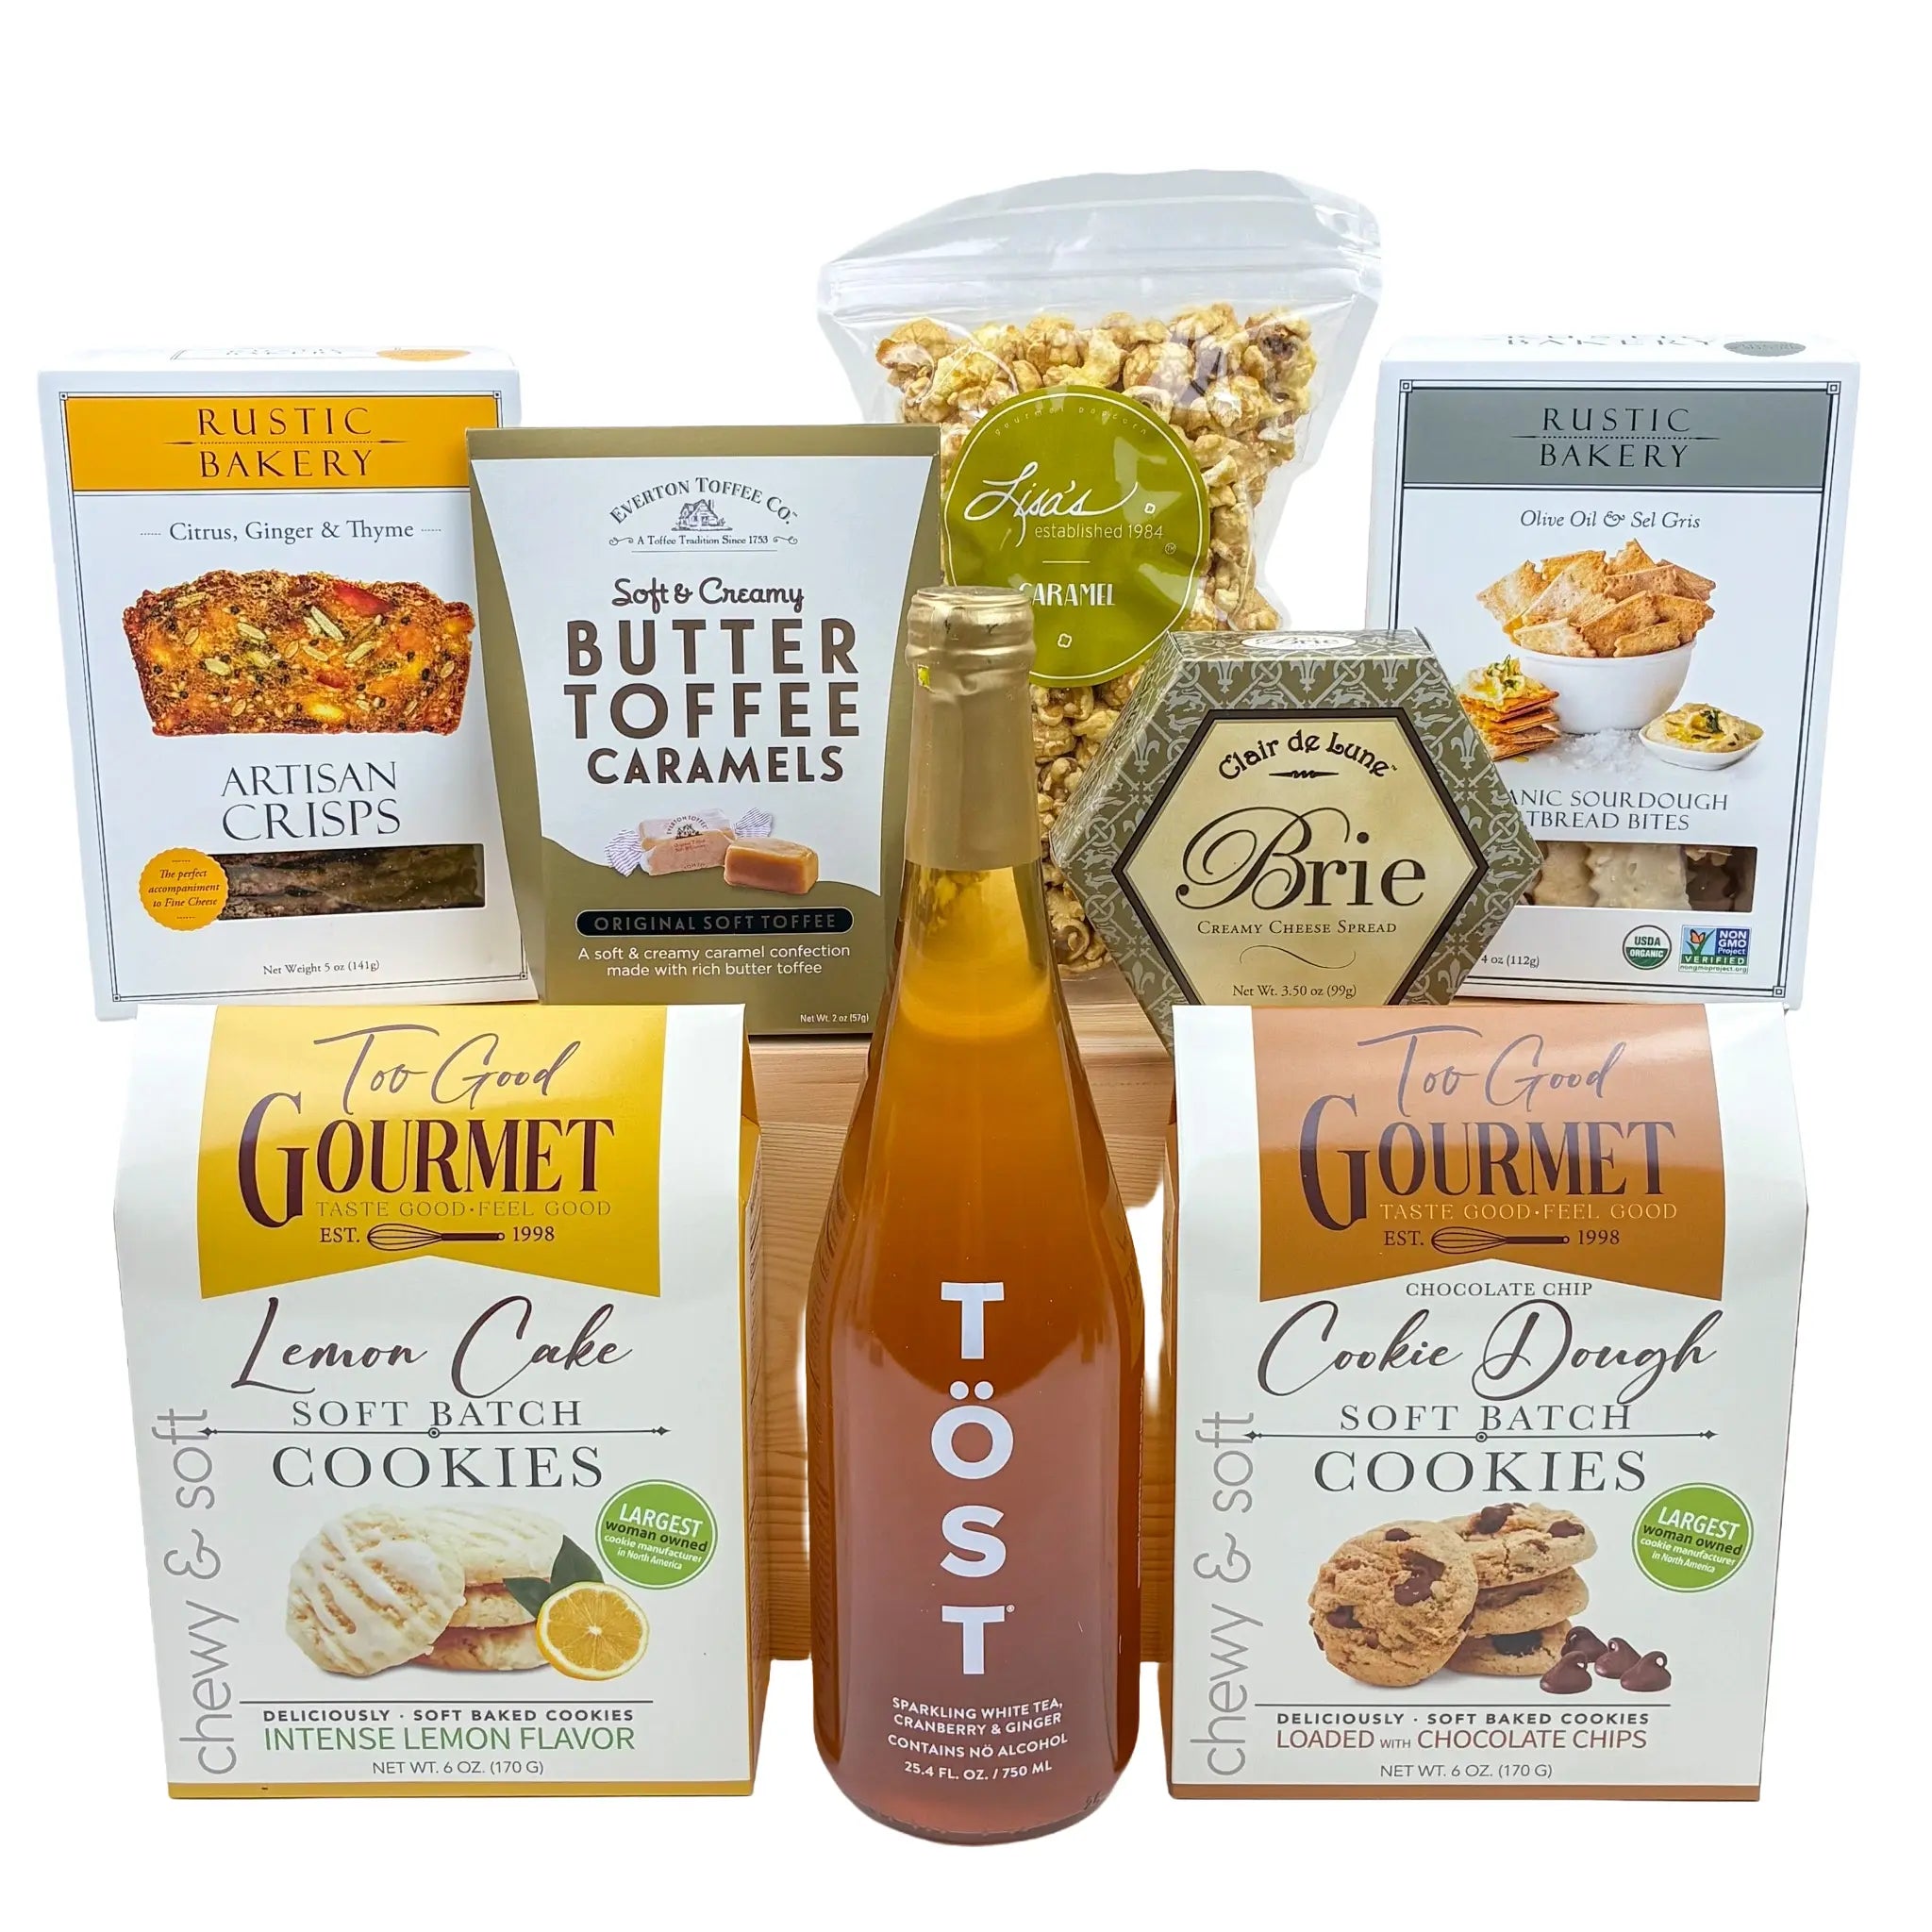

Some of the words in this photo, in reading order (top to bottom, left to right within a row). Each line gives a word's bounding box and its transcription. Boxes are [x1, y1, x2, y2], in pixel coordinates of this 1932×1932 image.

[197, 407, 373, 436] RUSTIC
[1542, 407, 1690, 433] RUSTIC
[201, 448, 374, 478] BAKERY
[1540, 442, 1689, 469] BAKERY
[609, 479, 691, 525] EVERTON
[695, 476, 763, 505] TOFFEE
[963, 461, 1140, 548] Lisa's
[169, 521, 238, 543] Citrus,
[245, 521, 313, 545] Ginger
[321, 522, 340, 540] &
[346, 518, 414, 543] Thyme
[1034, 524, 1123, 540] established
[1128, 524, 1164, 540] 1984
[1521, 510, 1565, 528] Olive
[1570, 510, 1597, 528] Oil
[1603, 511, 1625, 527] &
[1631, 512, 1656, 528] Sel
[1661, 512, 1701, 529] Gris
[647, 535, 676, 545] Toffee
[678, 535, 720, 545] Tradition
[722, 535, 747, 545] Since
[749, 535, 769, 545] 1753
[611, 576, 669, 614] Soft
[674, 584, 693, 605] &
[699, 576, 805, 613] Creamy
[567, 618, 859, 676] BUTTER
[563, 682, 859, 740] TOFFEE
[588, 745, 843, 785] CARAMELS
[1218, 740, 1279, 780] Clair
[1288, 729, 1321, 754] de
[221, 760, 397, 797] ARTISAN
[1571, 790, 1728, 811] SOURDOUGH
[223, 798, 401, 841] CRISPS
[1525, 810, 1620, 829] TBREAD
[1627, 811, 1690, 831] BITES
[1175, 807, 1426, 911] Brie
[177, 868, 207, 881] perfect
[148, 884, 220, 895] accompaniment
[593, 915, 696, 932] ORIGINAL
[704, 914, 754, 930] SOFT
[761, 913, 836, 929] TOFFEE
[1197, 920, 1262, 935] CREAMY
[1269, 920, 1331, 935] CHEESE
[1337, 920, 1397, 934] SPREAD
[1720, 929, 1747, 940] NON
[578, 947, 590, 960] A
[594, 946, 624, 960] soft
[628, 947, 641, 960] &
[643, 948, 700, 962] creamy
[705, 945, 765, 959] caramel
[769, 944, 851, 958] confection
[1629, 948, 1664, 958] ORGANIC
[1634, 936, 1660, 947] USDA
[1718, 939, 1747, 948] GMO
[1718, 947, 1746, 957] Project
[263, 964, 281, 976] Net
[285, 961, 321, 977] Weight
[348, 959, 380, 974] (141g)
[607, 963, 649, 976] made
[654, 962, 688, 975] with
[692, 962, 721, 975] rich
[725, 961, 773, 975] butter
[776, 961, 823, 974] toffee
[1507, 955, 1540, 969] (112g)
[1685, 956, 1745, 965] VERIFIED
[1232, 984, 1255, 998] Net
[1257, 984, 1278, 998] Wt.
[1281, 984, 1307, 998] 3.50
[1326, 983, 1357, 1001] (99g)
[313, 1024, 440, 1115] Too
[430, 1032, 581, 1111] Good
[1357, 1024, 1483, 1117] Too
[1485, 1034, 1627, 1112] Good
[238, 1091, 615, 1229] GOURMET
[1299, 1093, 1676, 1231] GOURMET
[316, 1201, 389, 1218] TASTE
[544, 1200, 612, 1217] GOOD
[1380, 1203, 1454, 1221] TASTE
[1610, 1203, 1678, 1220] GOOD
[320, 1227, 360, 1244] EST.
[512, 1225, 556, 1243] 1998
[1383, 1229, 1425, 1247] EST.
[1577, 1228, 1620, 1246] 1998
[1406, 1282, 1536, 1297] CHOCOLATE
[1542, 1281, 1592, 1297] CHIP
[230, 1296, 427, 1394] Lemon
[450, 1295, 633, 1399] Cake
[1257, 1300, 1464, 1396] Cookie
[1472, 1298, 1724, 1405] Dough
[292, 1400, 409, 1427] SOFT
[430, 1399, 582, 1427] BATCH
[1340, 1405, 1458, 1432] SOFT
[1483, 1403, 1632, 1431] BATCH
[151, 1407, 216, 1510] soft
[272, 1445, 603, 1490] COOKIES
[1194, 1410, 1255, 1514] soft
[1313, 1449, 1646, 1493] COOKIES
[619, 1502, 704, 1539] LARGEST
[1657, 1506, 1740, 1541] LARGEST
[604, 1534, 637, 1548] cookie
[637, 1541, 703, 1563] manufacturer
[606, 1520, 657, 1541] woman
[659, 1533, 708, 1553] owned
[1643, 1524, 1693, 1545] woman
[1695, 1537, 1743, 1557] owned
[650, 1555, 683, 1571] America
[1641, 1537, 1673, 1551] cookie
[1673, 1544, 1737, 1566] manufacturer
[1684, 1557, 1716, 1574] America
[178, 1600, 240, 1775] chewy
[1190, 1603, 1264, 1776] chewy
[263, 1709, 391, 1723] DELICIOUSLY
[413, 1708, 461, 1723] SOFT
[472, 1708, 537, 1723] BAKED
[546, 1708, 635, 1723] COOKIES
[892, 1697, 977, 1720] SPARKLING
[981, 1704, 1029, 1720] WHITE
[1033, 1697, 1063, 1715] TEA,
[1277, 1712, 1405, 1726] DELICIOUSLY
[1427, 1712, 1475, 1725] SOFT
[1486, 1712, 1552, 1725] BAKED
[1560, 1712, 1650, 1725] COOKIES
[893, 1713, 986, 1736] CRANBERRY
[991, 1724, 1002, 1735] &
[1006, 1711, 1062, 1734] GINGER
[264, 1726, 395, 1751] INTENSE
[405, 1726, 511, 1751] LEMON
[521, 1726, 636, 1750] FLAVOR
[887, 1733, 965, 1758] CONTAINS
[969, 1743, 994, 1758] NÖ
[997, 1733, 1068, 1757] ALCOHOL
[1276, 1729, 1374, 1750] LOADED
[1379, 1738, 1411, 1750] WITH
[1417, 1728, 1566, 1750] CHOCOLATE
[1573, 1729, 1648, 1750] CHIPS
[372, 1761, 406, 1774] NET
[409, 1760, 440, 1774] WT.
[457, 1760, 485, 1774] OZ.
[490, 1759, 522, 1776] (170
[904, 1760, 935, 1777] 25.4
[939, 1767, 959, 1780] FL.
[963, 1768, 989, 1781] OZ.
[1002, 1765, 1028, 1779] 750
[1032, 1759, 1053, 1774] ML
[1379, 1764, 1414, 1778] NET
[1417, 1764, 1446, 1778] WT.
[1464, 1763, 1493, 1778] OZ.
[1498, 1763, 1530, 1779] (170
